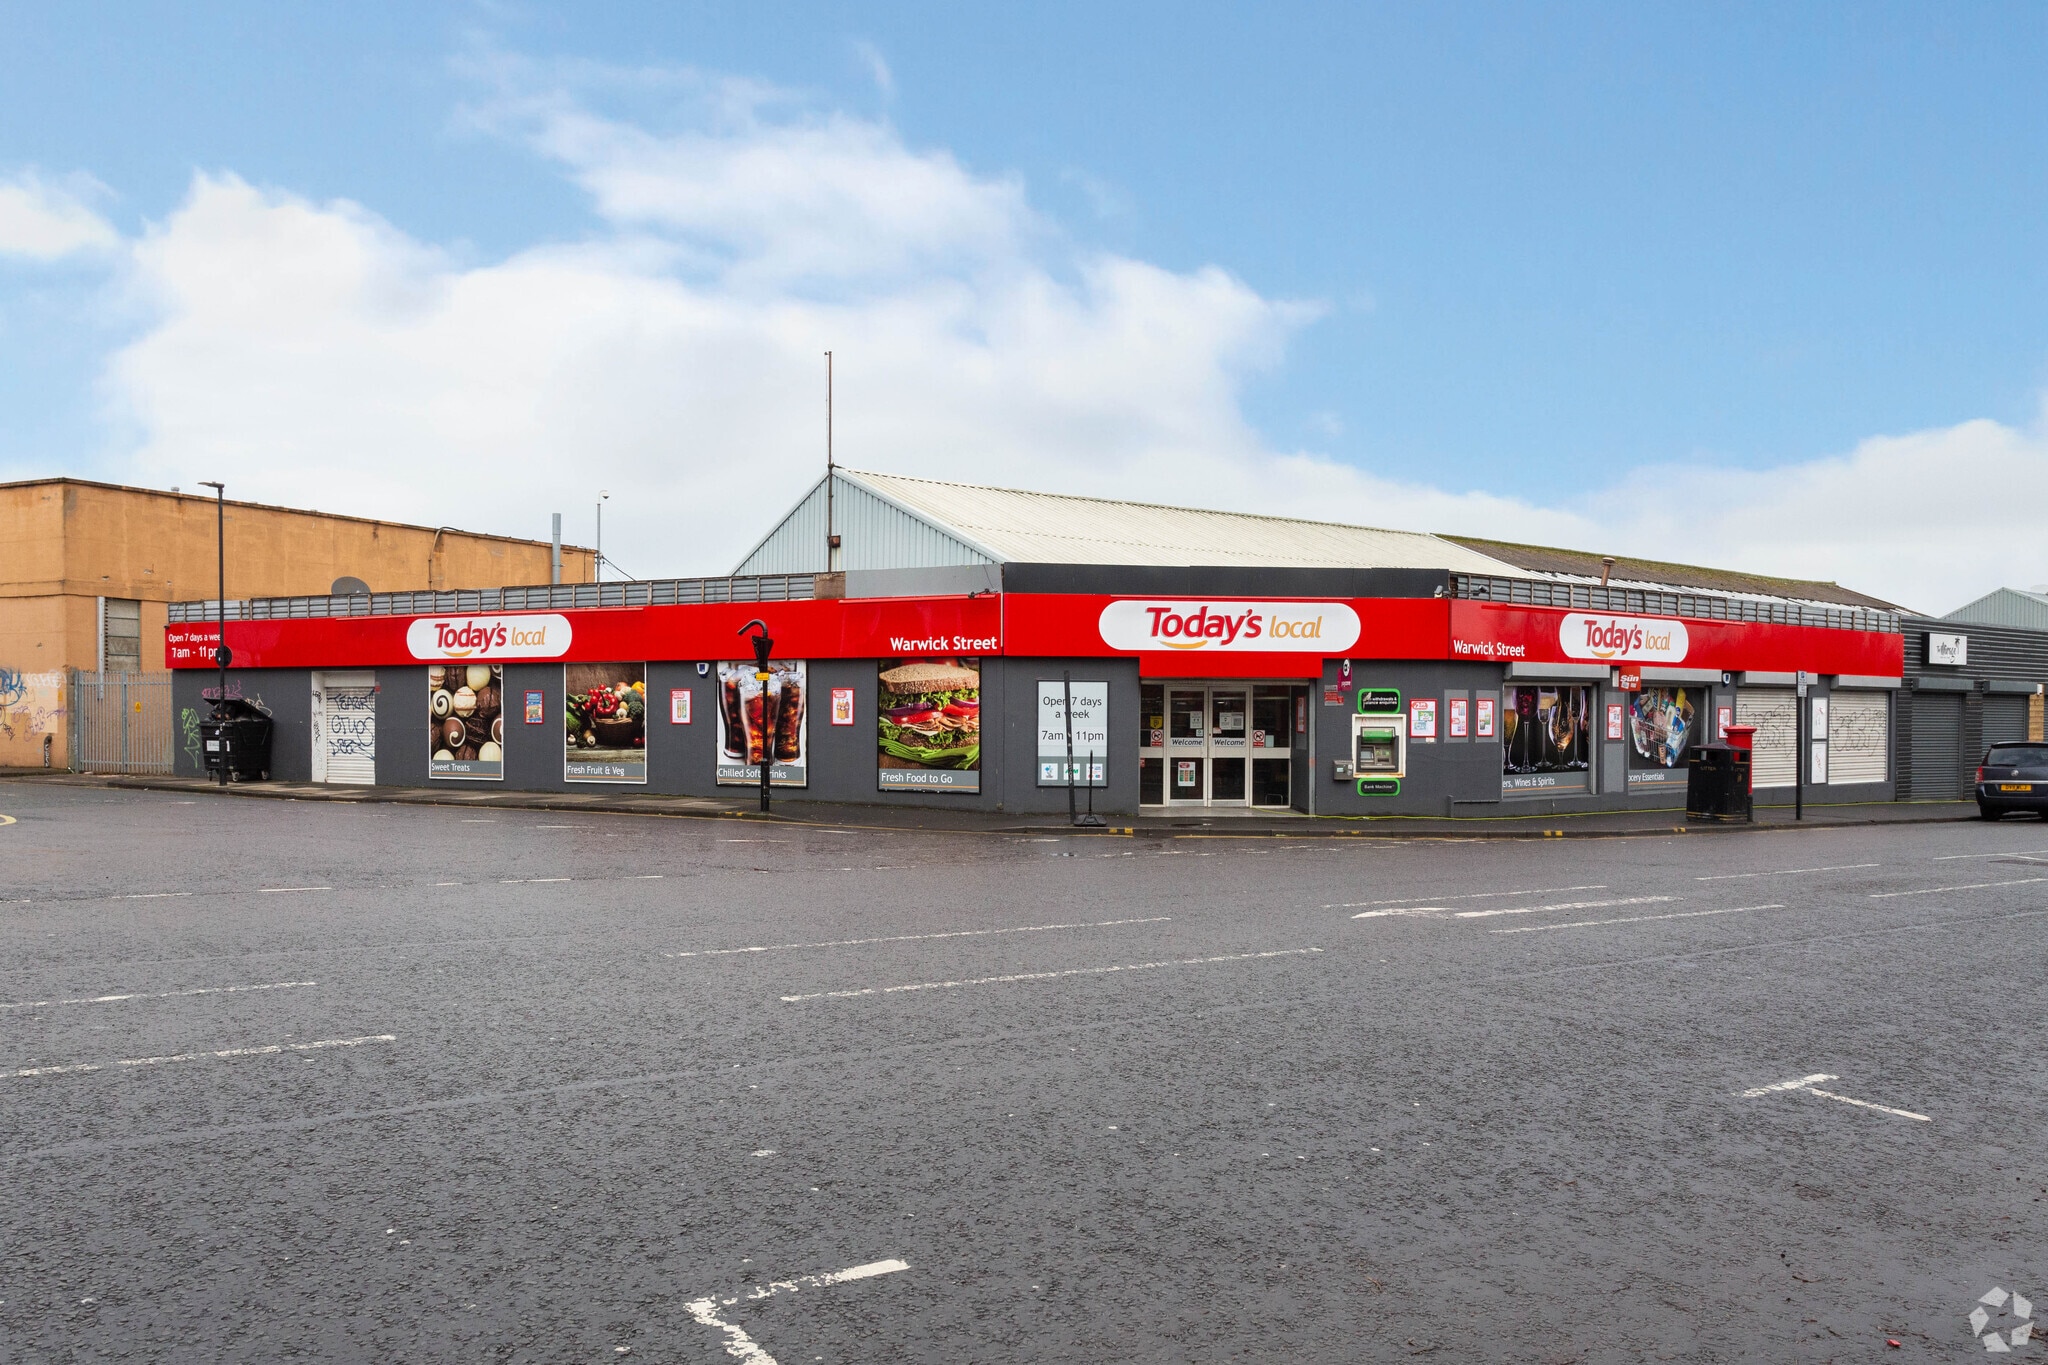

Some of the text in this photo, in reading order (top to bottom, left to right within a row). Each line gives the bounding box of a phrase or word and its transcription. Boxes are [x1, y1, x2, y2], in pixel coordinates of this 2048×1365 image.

[1145, 605, 1323, 646] Today's local
[168, 633, 184, 643] Open
[185, 633, 189, 641] 7
[189, 633, 203, 643] days
[434, 620, 546, 654] Today's local
[890, 635, 998, 651] Warwick Street
[1583, 619, 1671, 656] Today's local
[171, 647, 190, 658] 7am
[1453, 639, 1526, 657] Warwick Street
[1071, 696, 1077, 706] 7
[1080, 696, 1102, 708] days
[1055, 711, 1061, 719] a
[1042, 730, 1104, 743] 7am 11pm
[1172, 738, 1203, 746] Welcome
[431, 763, 470, 772] Sweet Treats
[567, 765, 625, 777] Fresh Fruit & Veg
[718, 768, 744, 777] Chilled
[746, 768, 761, 778] Soft
[881, 772, 953, 784] Fresh Food to Go
[1514, 778, 1531, 787] Wines
[1531, 777, 1537, 786] &
[1537, 776, 1555, 788] Spirits
[1641, 772, 1665, 781] Essentials
